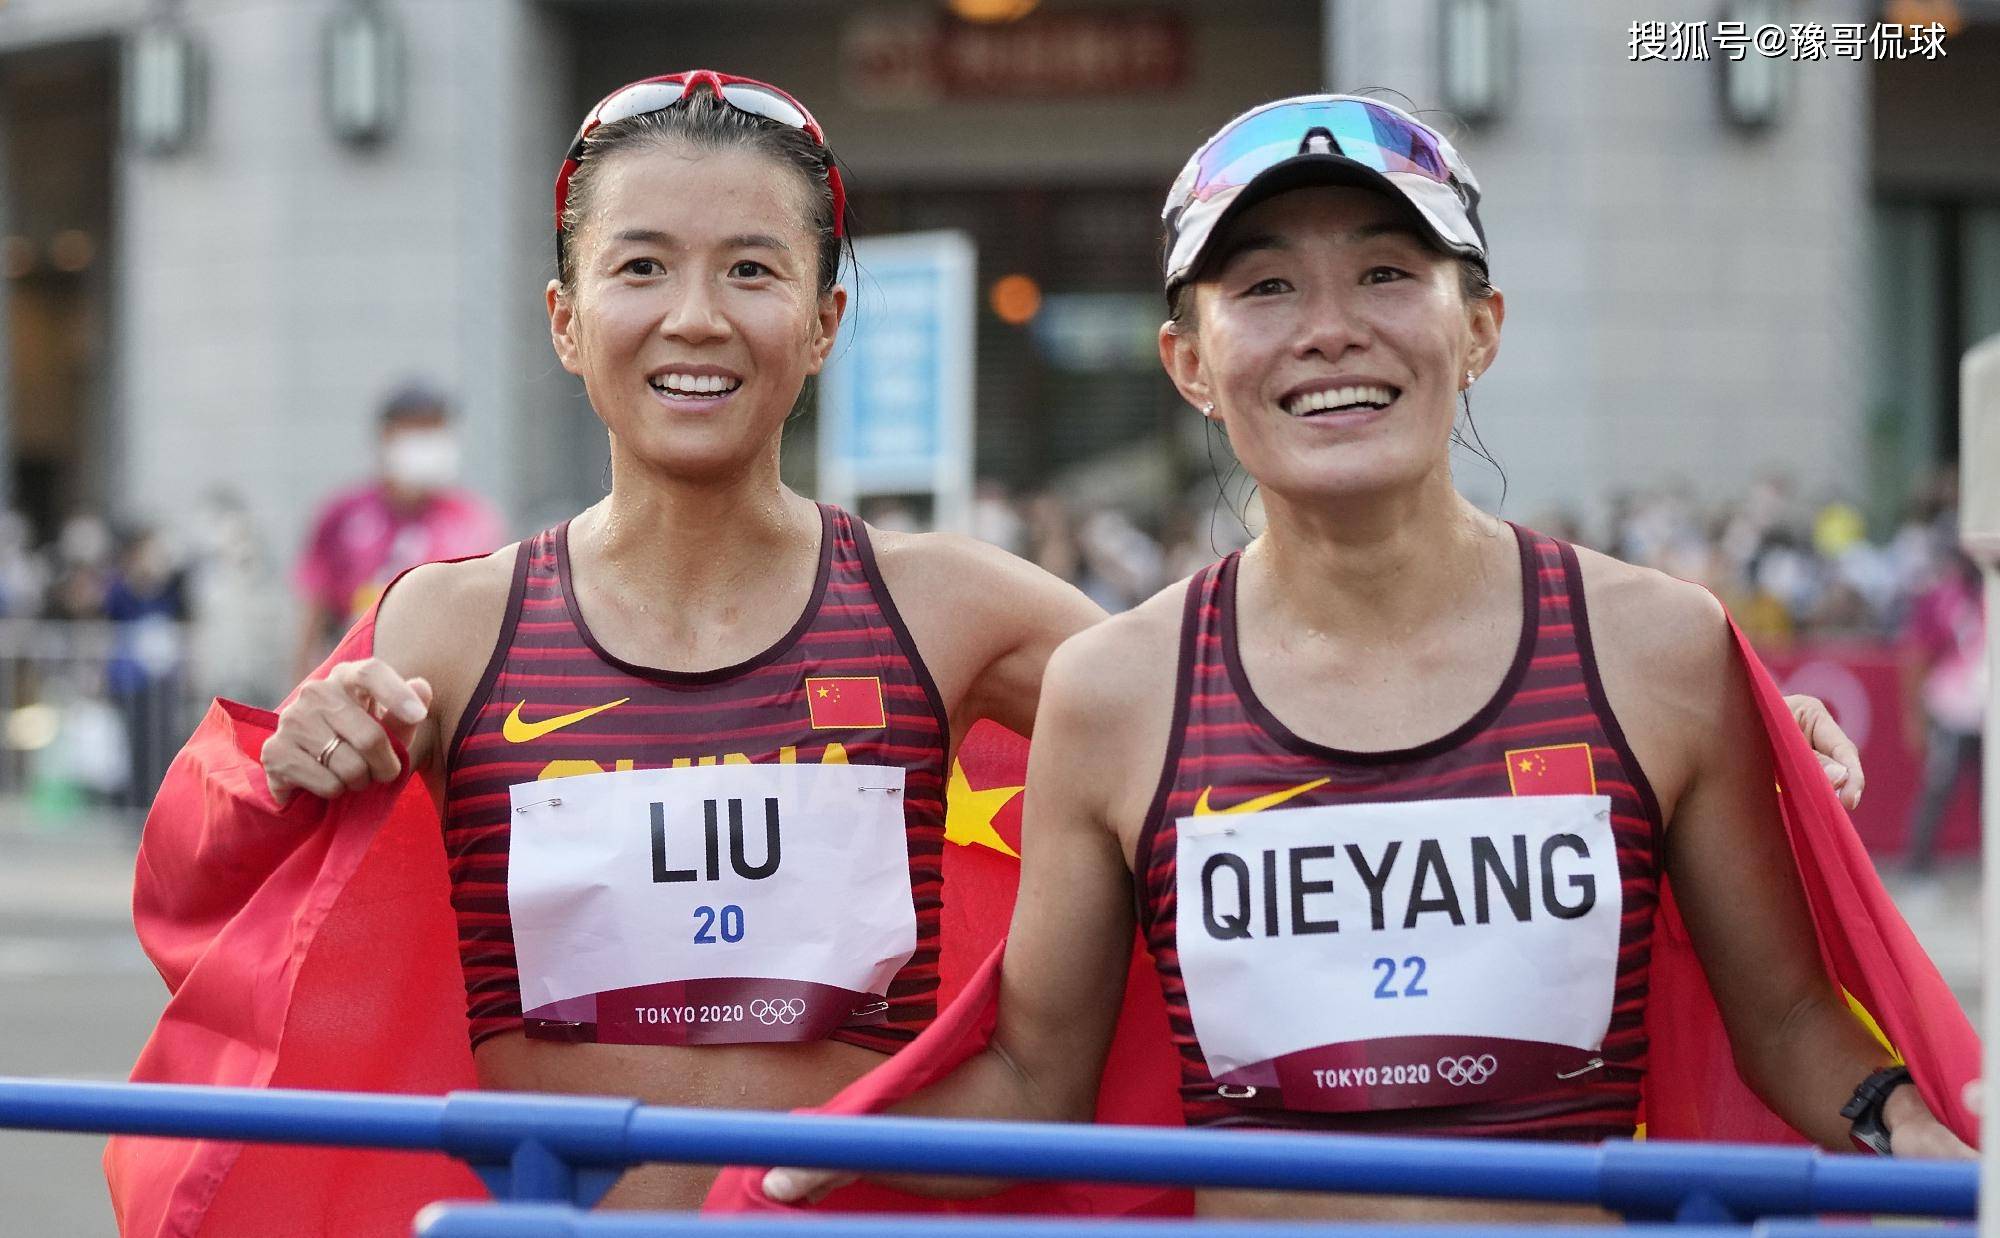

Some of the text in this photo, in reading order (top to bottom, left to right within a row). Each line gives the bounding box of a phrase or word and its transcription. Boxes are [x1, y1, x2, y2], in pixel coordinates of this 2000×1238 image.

[649, 797, 782, 884] LIU
[1200, 833, 1597, 941] QIEYANG
[693, 904, 746, 945] 20
[1372, 955, 1430, 1001] 22
[635, 1004, 744, 1024] TOKYO 2020
[1312, 1063, 1431, 1088] TOKYO 2020
